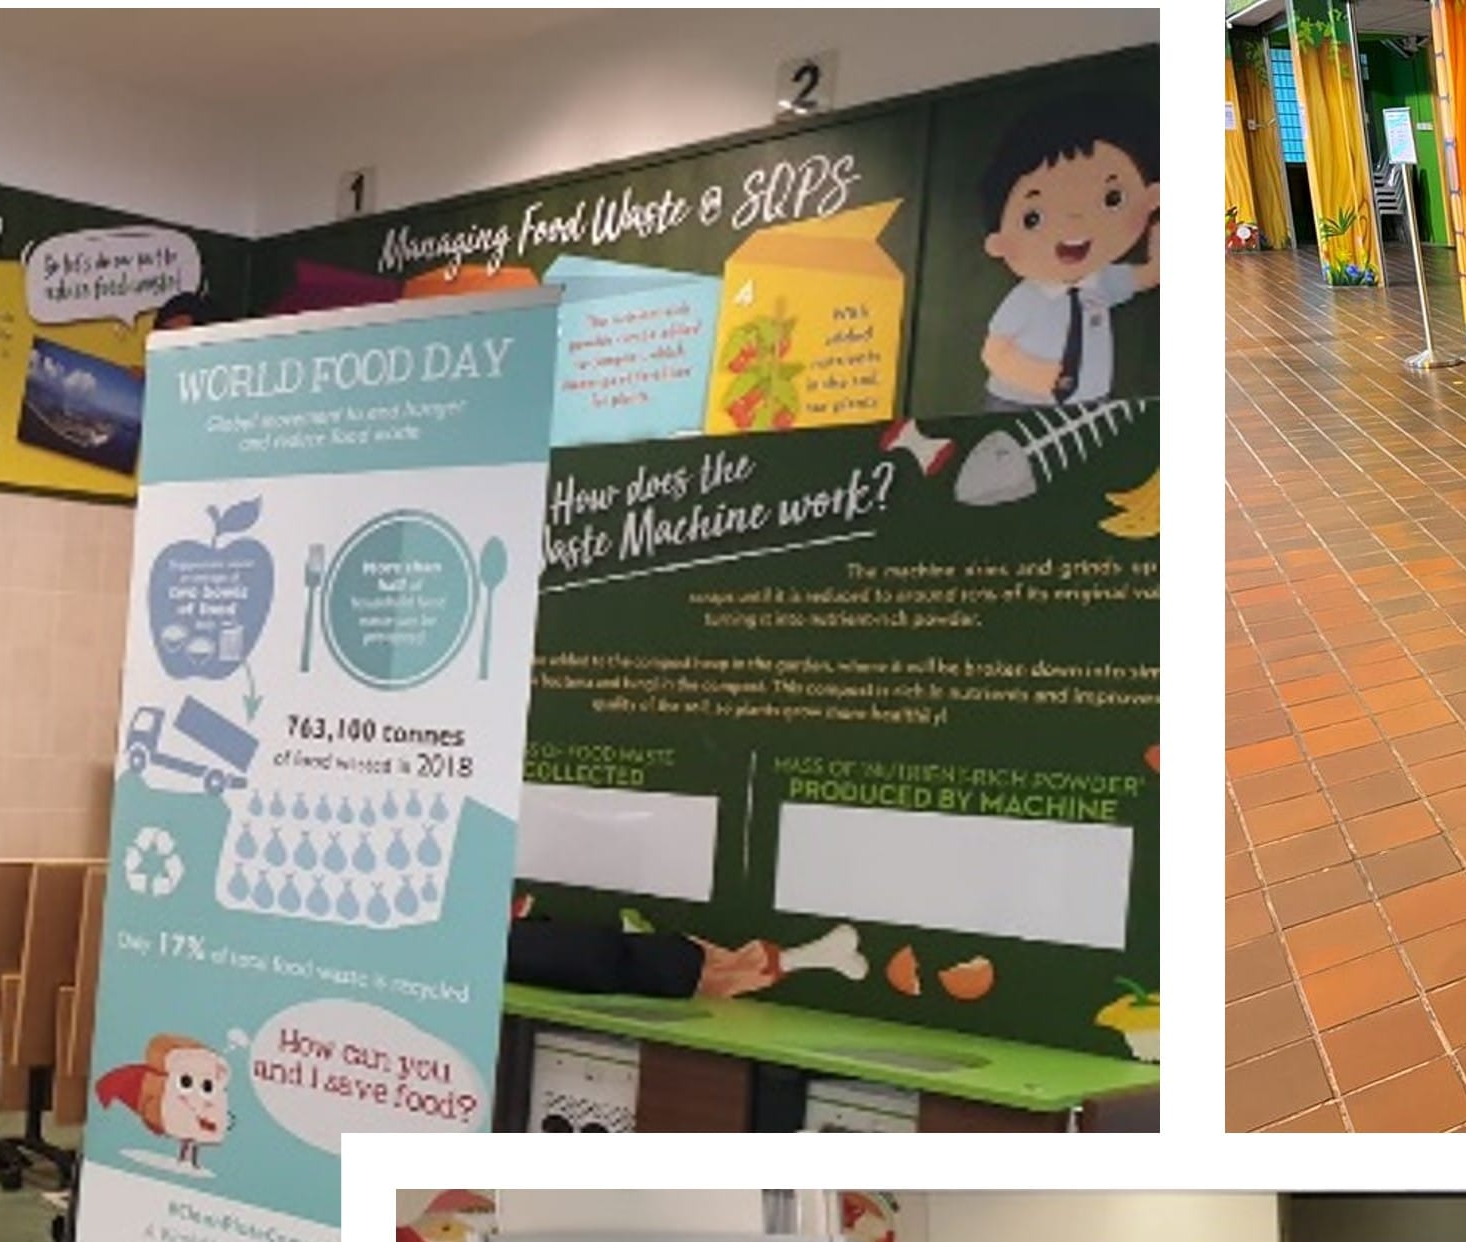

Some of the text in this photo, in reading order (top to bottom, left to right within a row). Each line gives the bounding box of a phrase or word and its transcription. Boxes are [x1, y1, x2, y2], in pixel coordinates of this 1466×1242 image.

[792, 64, 819, 108] 2
[347, 172, 366, 213] 1
[378, 219, 512, 281] Managing
[518, 202, 587, 257] Food
[591, 187, 695, 247] Waste
[732, 155, 862, 231] SQPS
[94, 271, 128, 301] food
[178, 358, 303, 405] WORLD
[311, 346, 414, 394] FOOD
[422, 337, 515, 382] DAY
[331, 427, 368, 445] food
[551, 449, 756, 526] How does the
[619, 504, 772, 561] Machine
[778, 461, 895, 526] work?
[362, 560, 443, 576] More than
[378, 578, 408, 592] half
[847, 561, 878, 579] The
[883, 562, 956, 578] machine
[1017, 558, 1053, 577] and
[1060, 559, 1122, 581] grinds
[1030, 659, 1083, 678] down
[1033, 685, 1069, 705] and
[287, 713, 466, 747] 763,100 tonnes
[273, 751, 291, 767] of
[293, 750, 332, 771] food
[417, 752, 474, 779] 2018
[523, 759, 645, 787] COLLECTED
[774, 755, 824, 777] MASS
[828, 759, 857, 778] OF
[789, 775, 1120, 822] PRODUCED BY MACHINE
[159, 931, 206, 962] 17%
[272, 954, 314, 979] food
[393, 978, 470, 1005] recycled
[279, 1028, 451, 1085] How can you
[253, 1059, 304, 1090] and
[323, 1072, 389, 1104] save
[393, 1081, 478, 1124] food?
